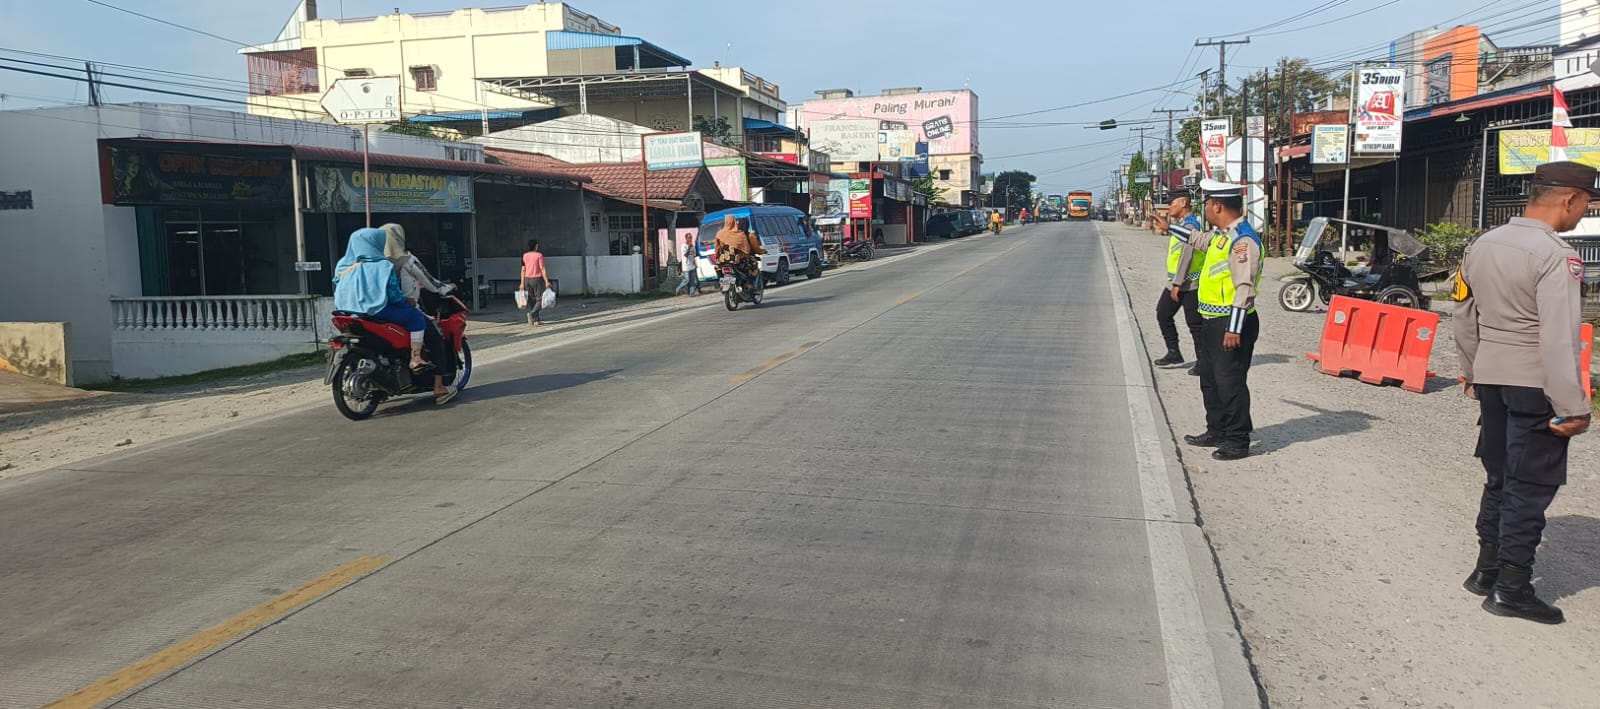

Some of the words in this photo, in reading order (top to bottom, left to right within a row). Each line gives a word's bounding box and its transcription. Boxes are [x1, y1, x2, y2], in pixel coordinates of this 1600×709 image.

[873, 102, 908, 114] Paling
[914, 96, 956, 110] Murah!
[925, 117, 948, 130] GRATIS
[840, 132, 876, 140] BAKERY
[926, 124, 952, 138] ONLINE
